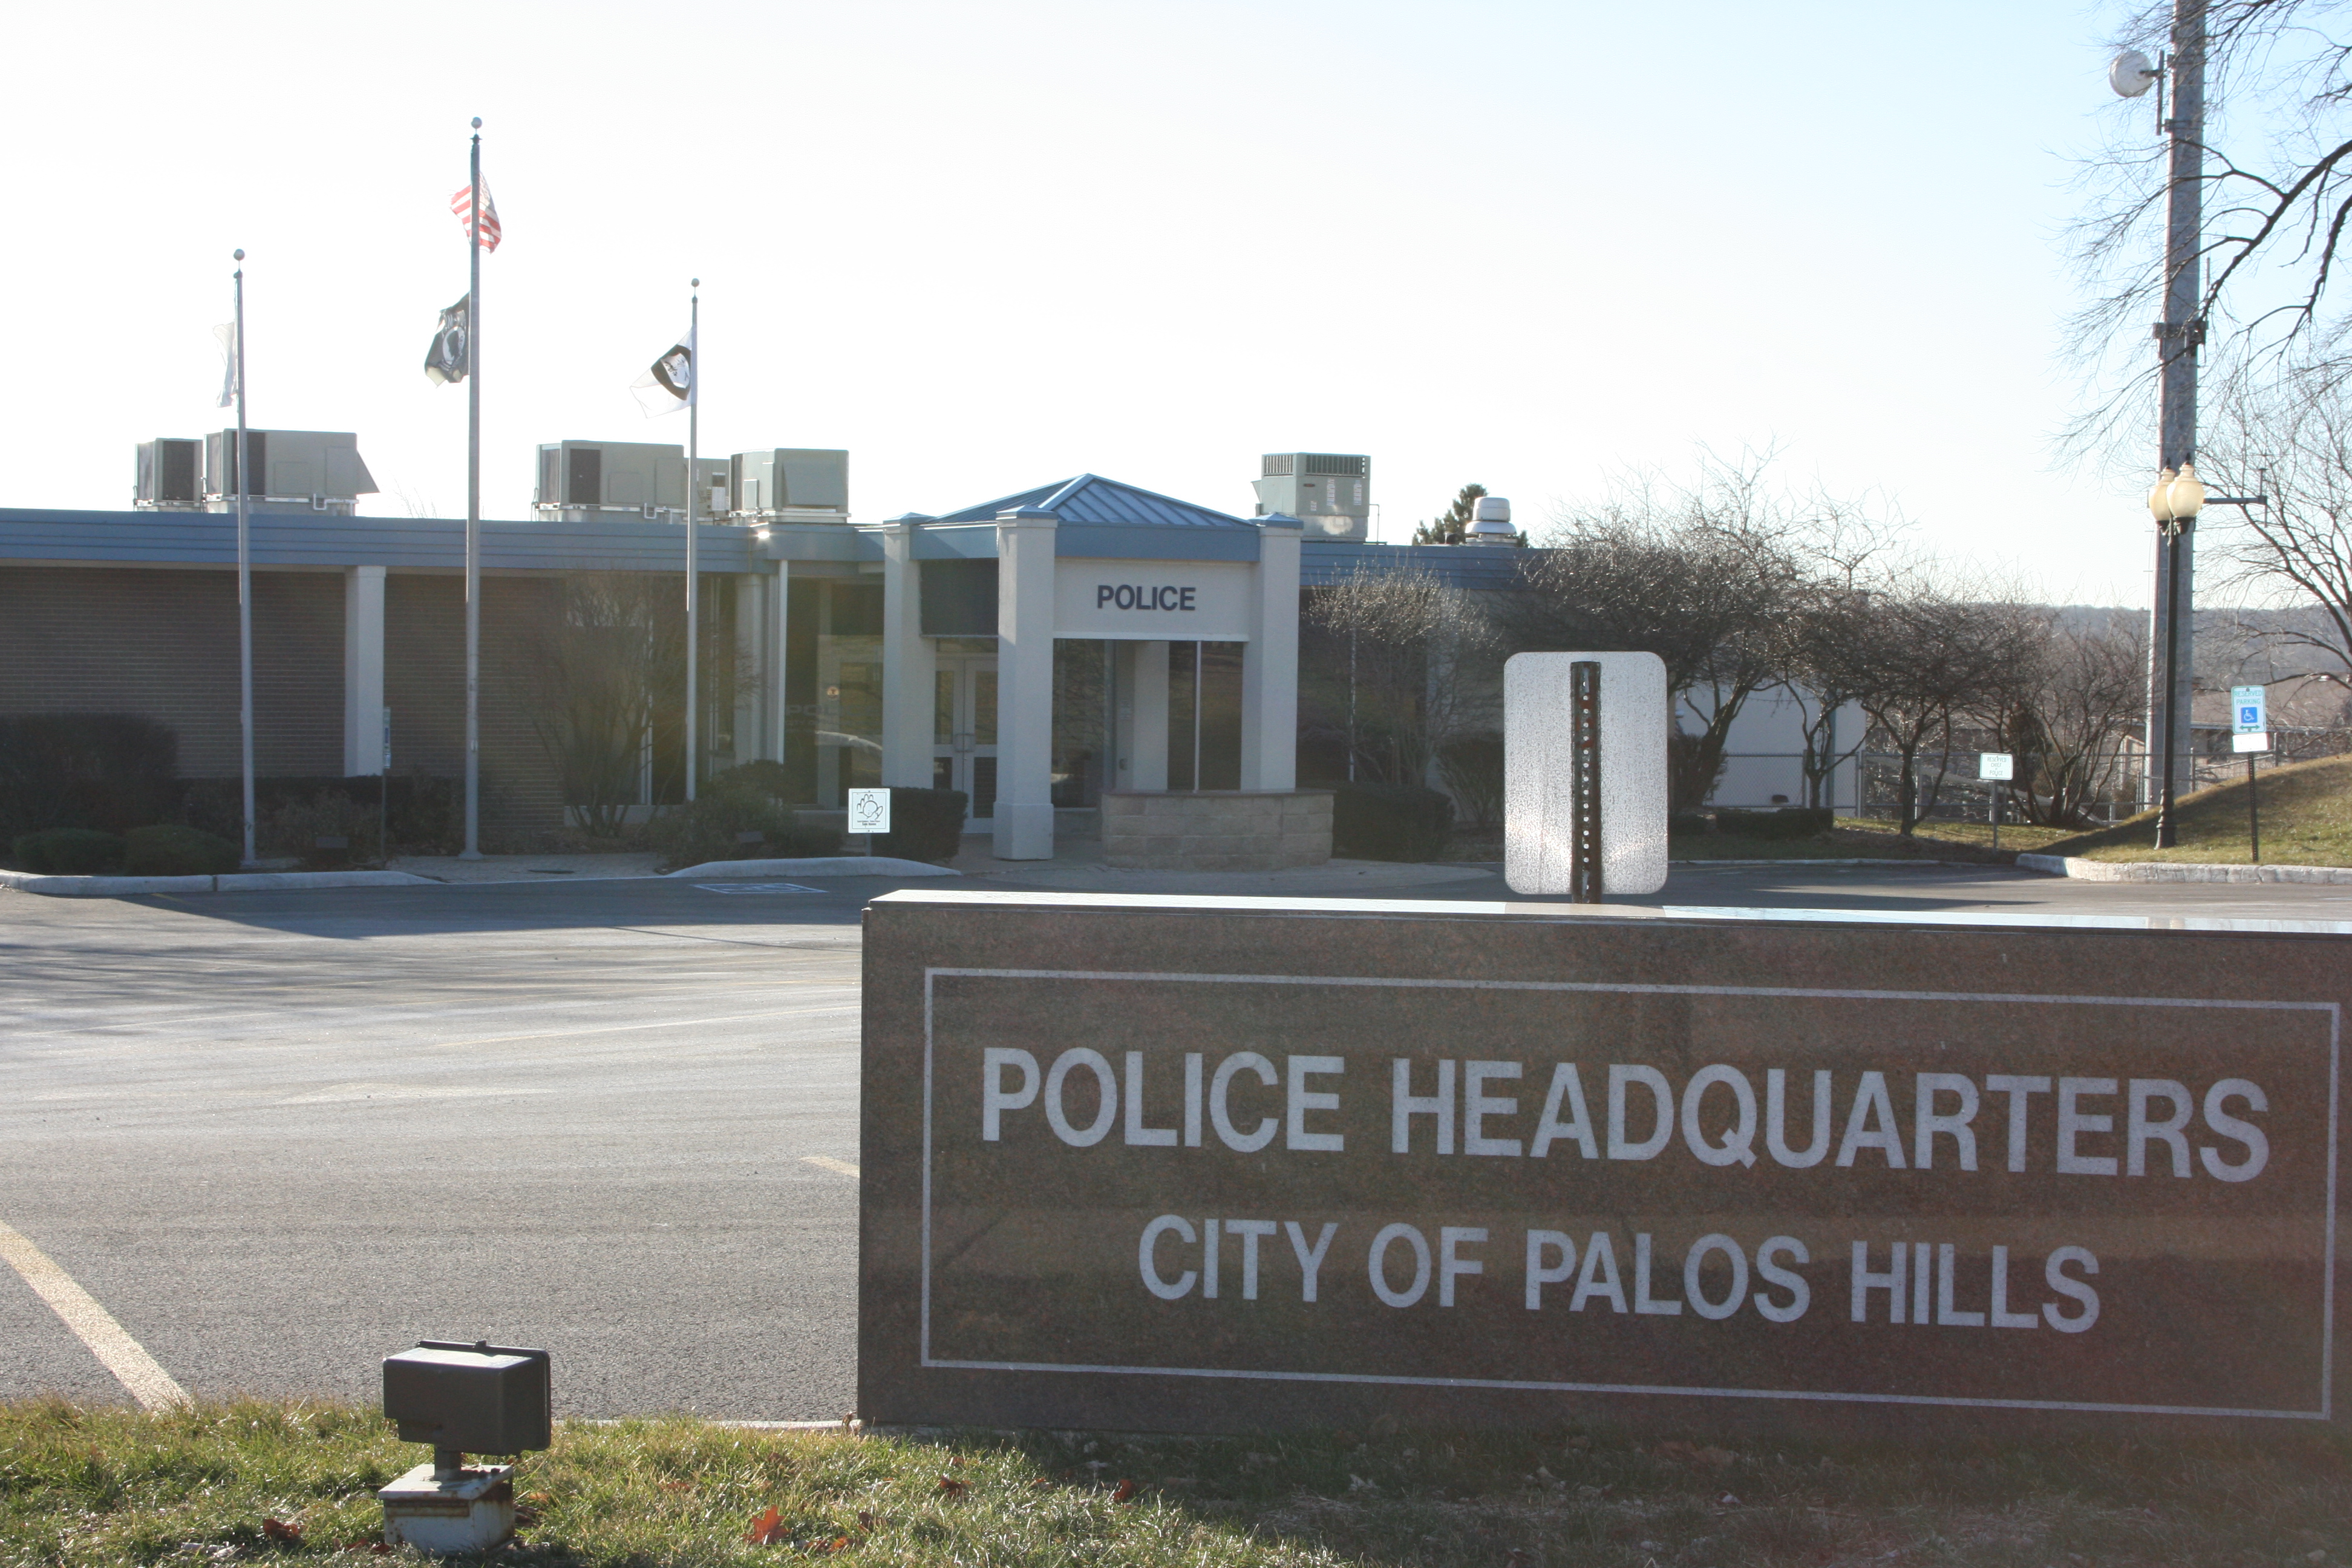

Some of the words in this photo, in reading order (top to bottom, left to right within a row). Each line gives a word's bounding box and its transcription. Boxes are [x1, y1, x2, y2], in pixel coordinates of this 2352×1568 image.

[1097, 584, 1196, 611] POLICE
[982, 1047, 1344, 1152] POLICE
[1391, 1057, 2269, 1183] HEADQUARTERS
[1138, 1214, 1339, 1302] CITY
[1368, 1222, 1489, 1308] OF
[1525, 1228, 1810, 1322] PALOS
[1851, 1240, 2100, 1333] HILLS
